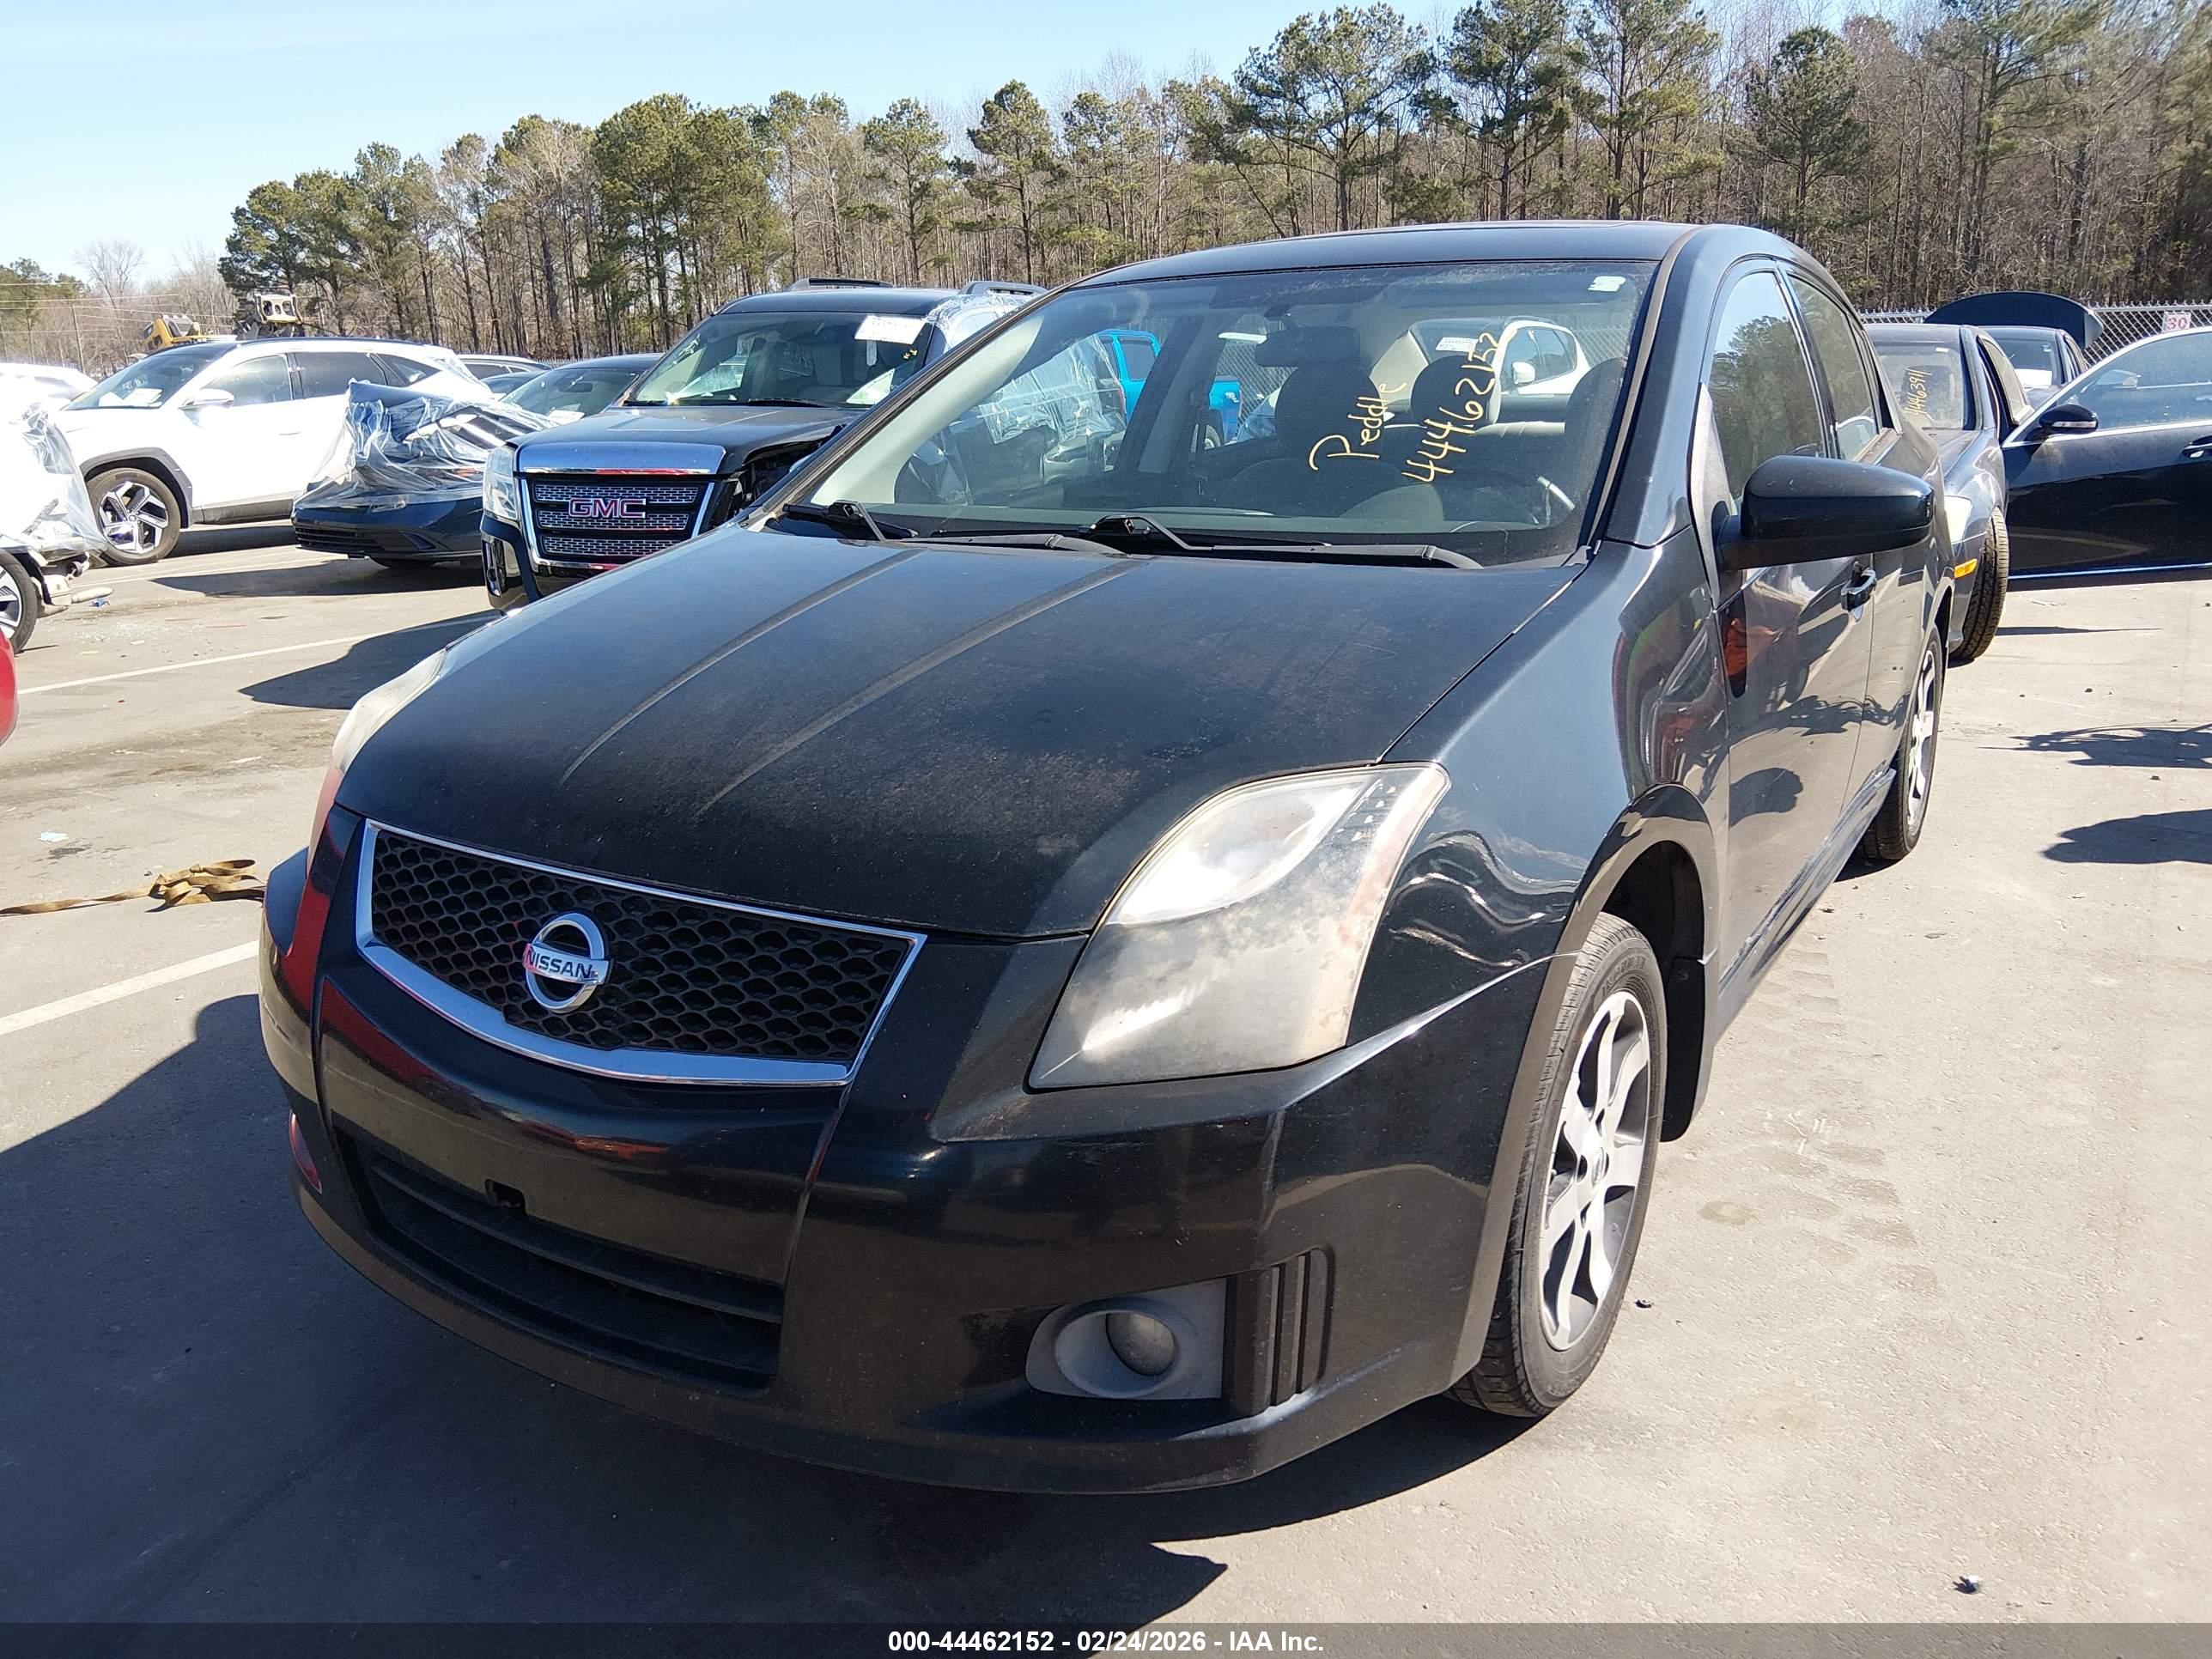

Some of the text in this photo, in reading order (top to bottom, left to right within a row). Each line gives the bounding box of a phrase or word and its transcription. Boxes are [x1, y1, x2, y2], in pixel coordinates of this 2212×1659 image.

[2166, 317, 2188, 331] 30
[1401, 332, 1499, 483] 44462152
[1309, 383, 1407, 471] Peddle
[568, 498, 646, 519] GMC
[526, 949, 593, 979] NISSAN
